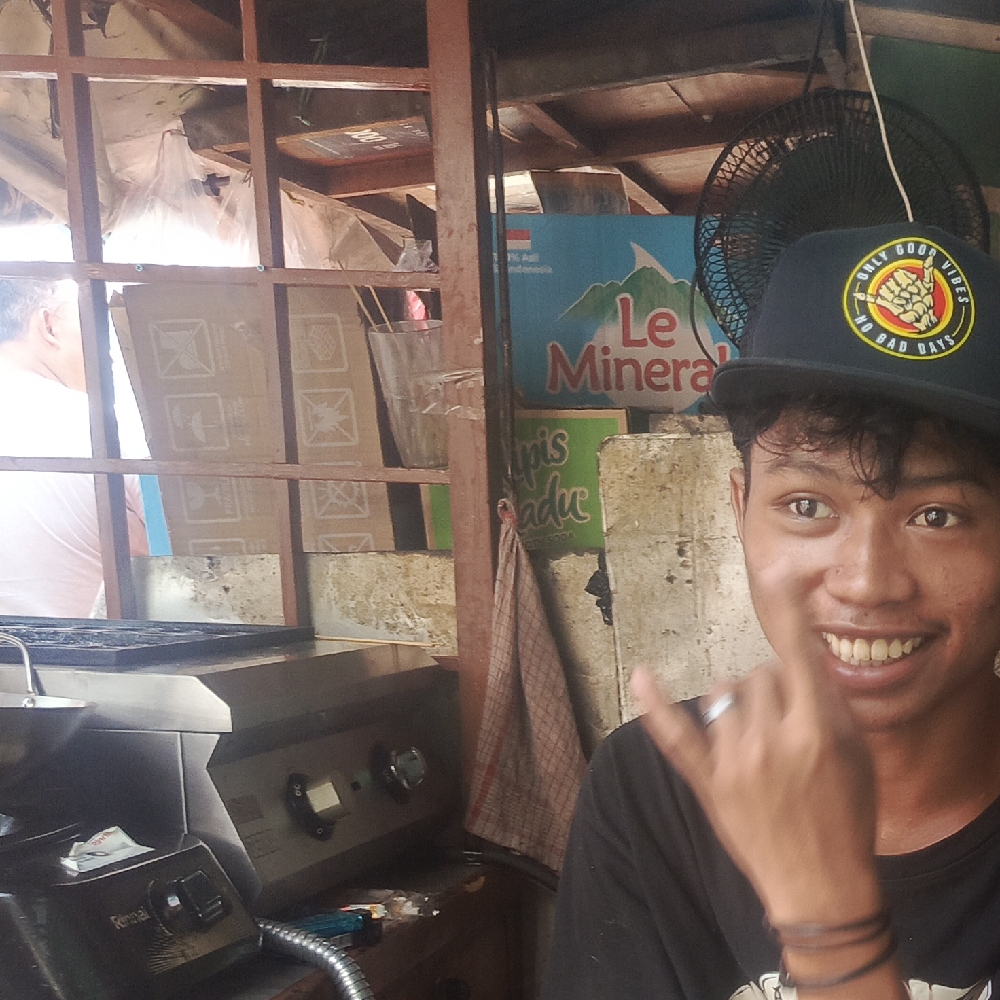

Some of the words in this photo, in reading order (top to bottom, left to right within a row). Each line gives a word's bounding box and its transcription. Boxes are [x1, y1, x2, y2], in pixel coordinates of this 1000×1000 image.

[856, 250, 889, 281] ONLY
[895, 242, 937, 257] GOOD
[941, 259, 970, 304] VIBES
[617, 294, 678, 349] Le
[854, 314, 874, 333] NO
[875, 333, 908, 353] BAD
[917, 334, 955, 355] DAYS
